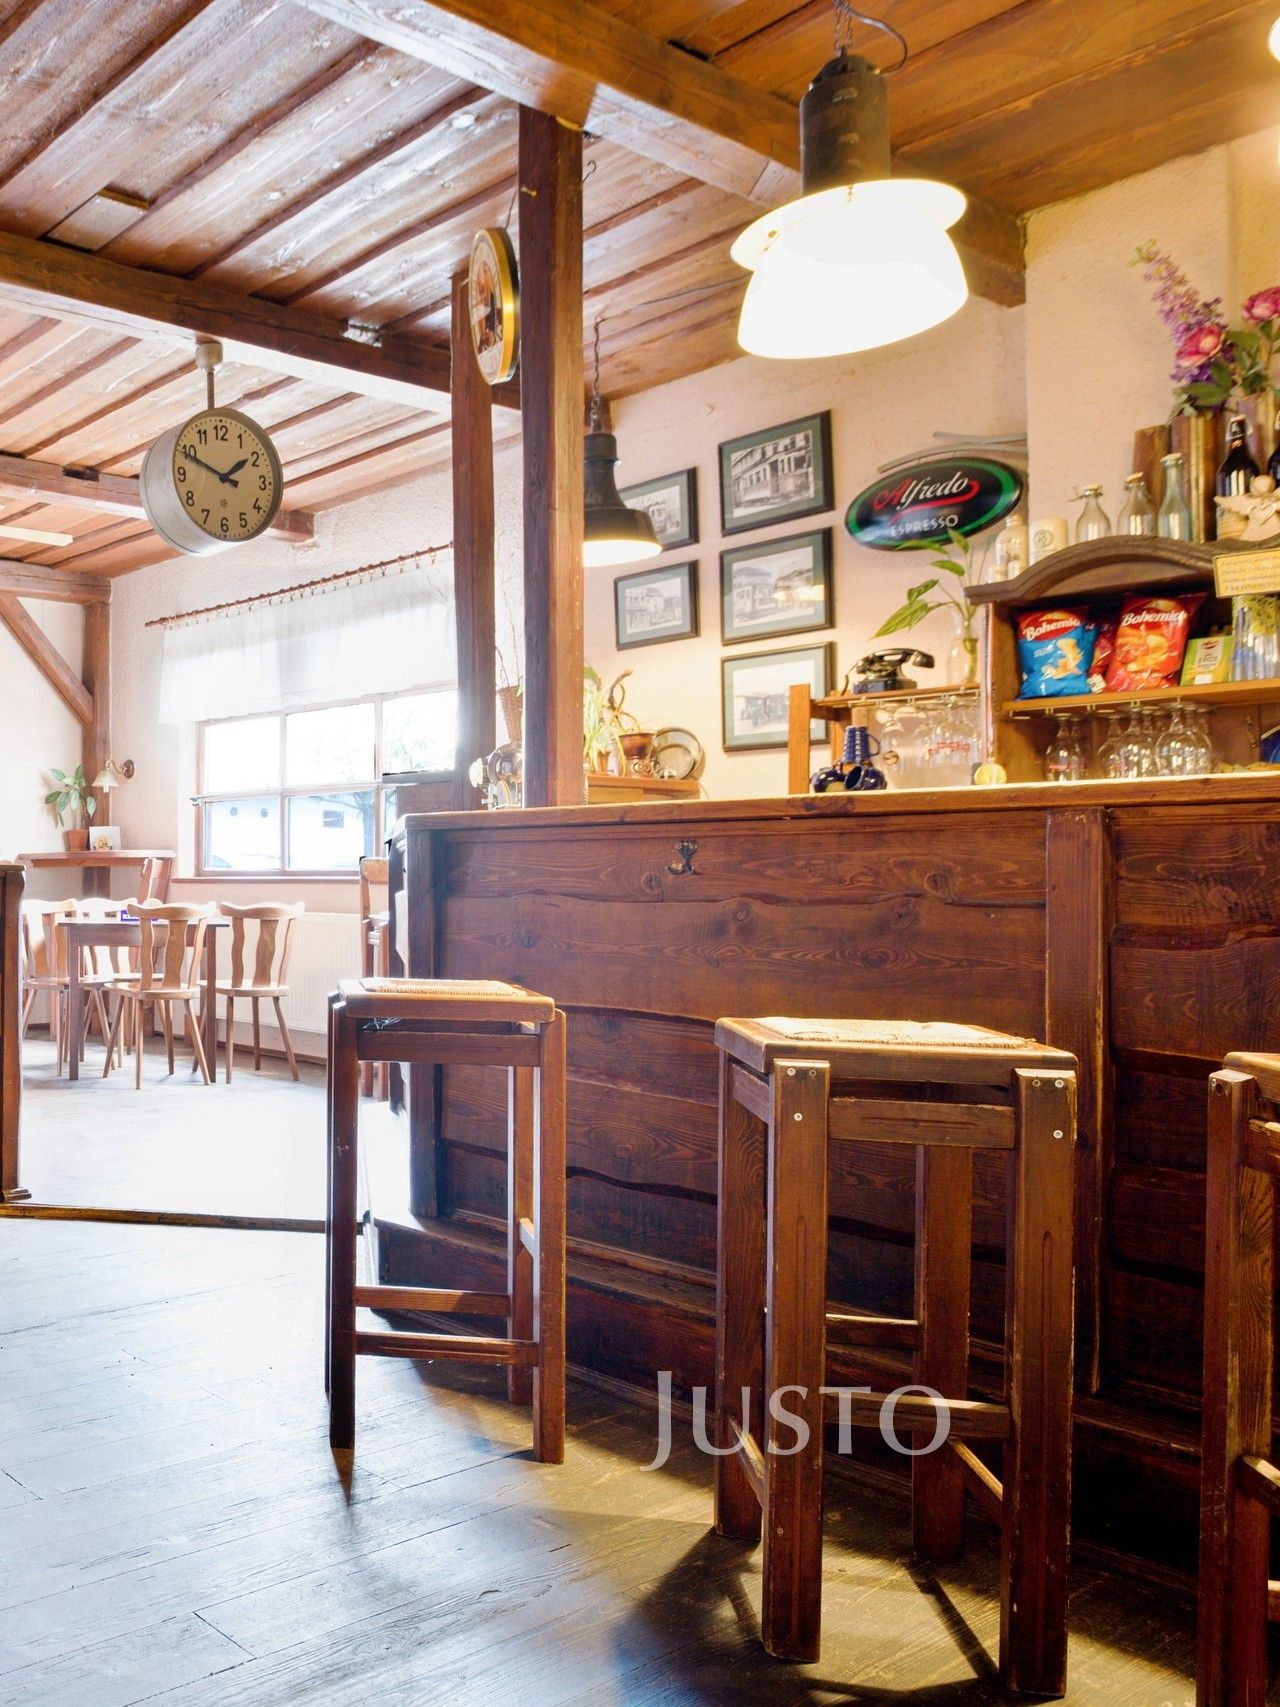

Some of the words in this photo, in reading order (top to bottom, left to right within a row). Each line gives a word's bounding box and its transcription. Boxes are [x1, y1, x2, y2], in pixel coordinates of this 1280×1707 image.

[196, 429, 208, 445] 11
[213, 424, 229, 442] 12
[237, 434, 242, 449] 1
[182, 444, 197, 460] 10
[251, 451, 260, 467] 2
[177, 467, 186, 483] 9
[258, 475, 267, 491] 3
[186, 491, 195, 507] 8
[873, 470, 970, 512] Alfredo
[253, 497, 262, 513] 4
[201, 509, 210, 524] 7
[239, 513, 248, 529] 5
[220, 517, 229, 533] 6
[890, 513, 959, 538] ESPRESSO
[1121, 609, 1187, 627] Bohemia
[1022, 617, 1081, 642] Bohemia
